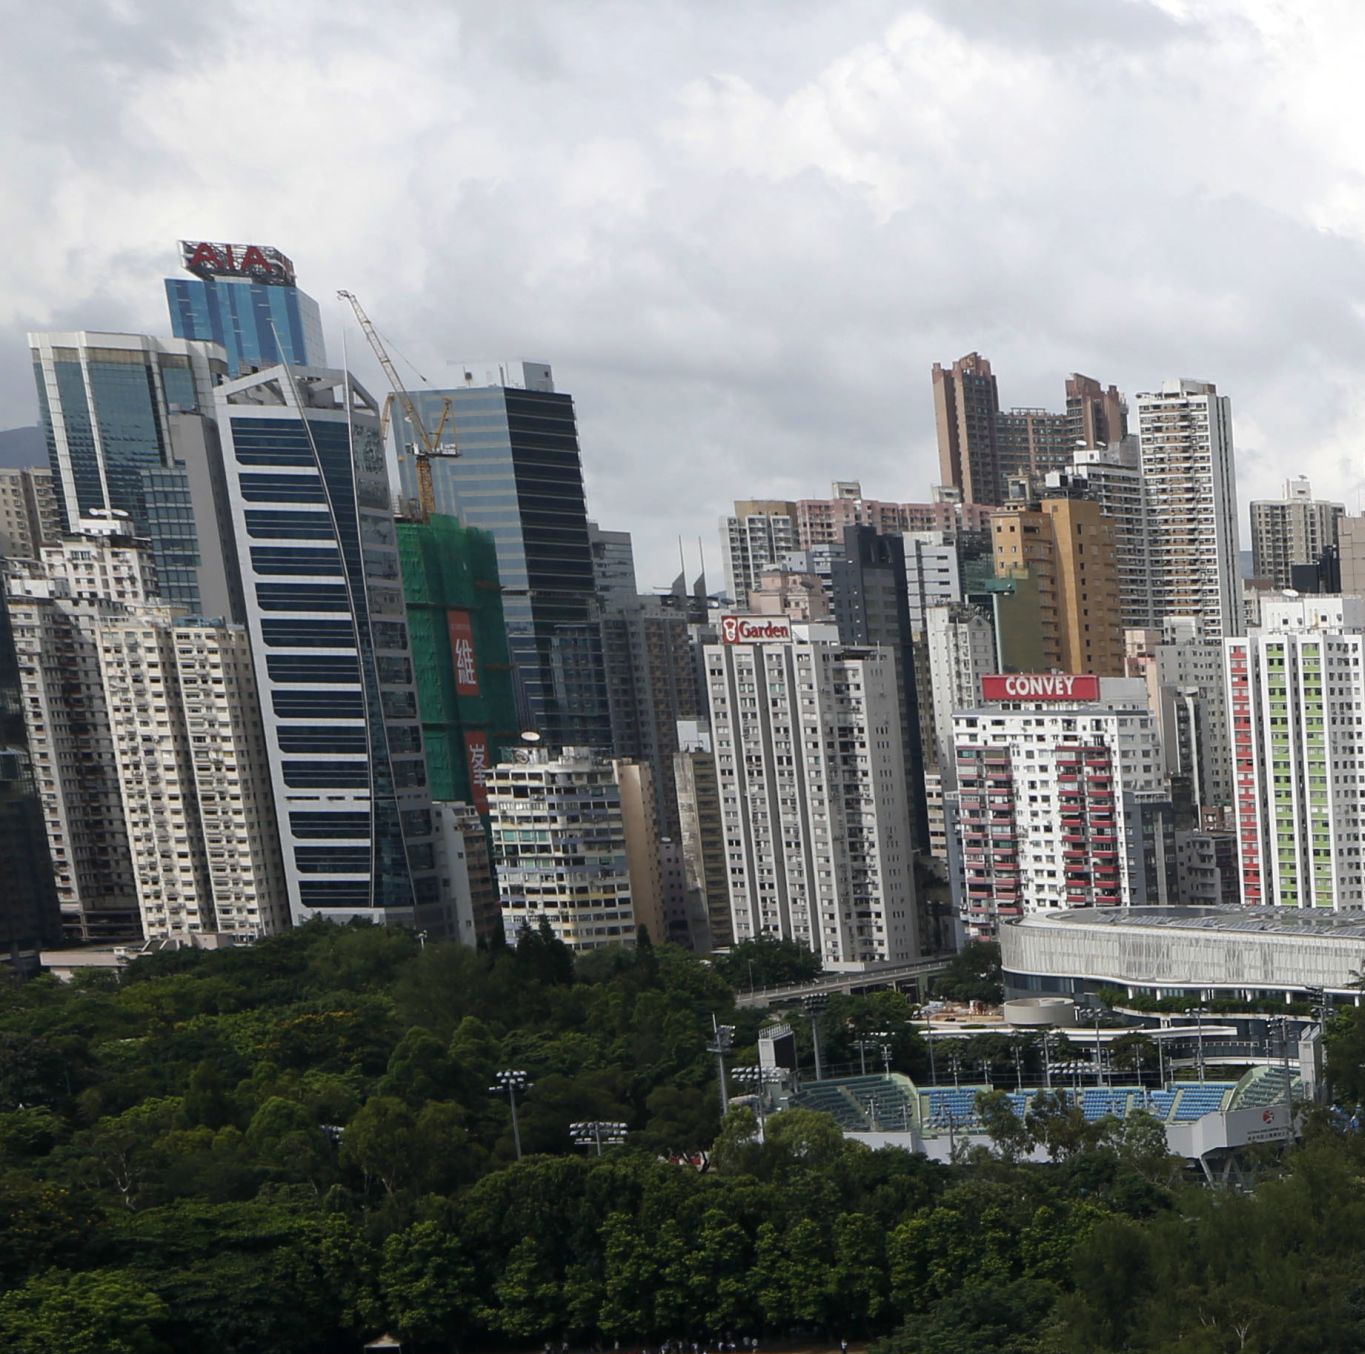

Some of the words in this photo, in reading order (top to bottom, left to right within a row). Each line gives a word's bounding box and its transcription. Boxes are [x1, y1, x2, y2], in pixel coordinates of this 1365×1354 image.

[190, 241, 273, 272] AIA
[739, 621, 788, 638] Garden
[456, 639, 476, 685] 維
[1005, 676, 1075, 695] CONVEY
